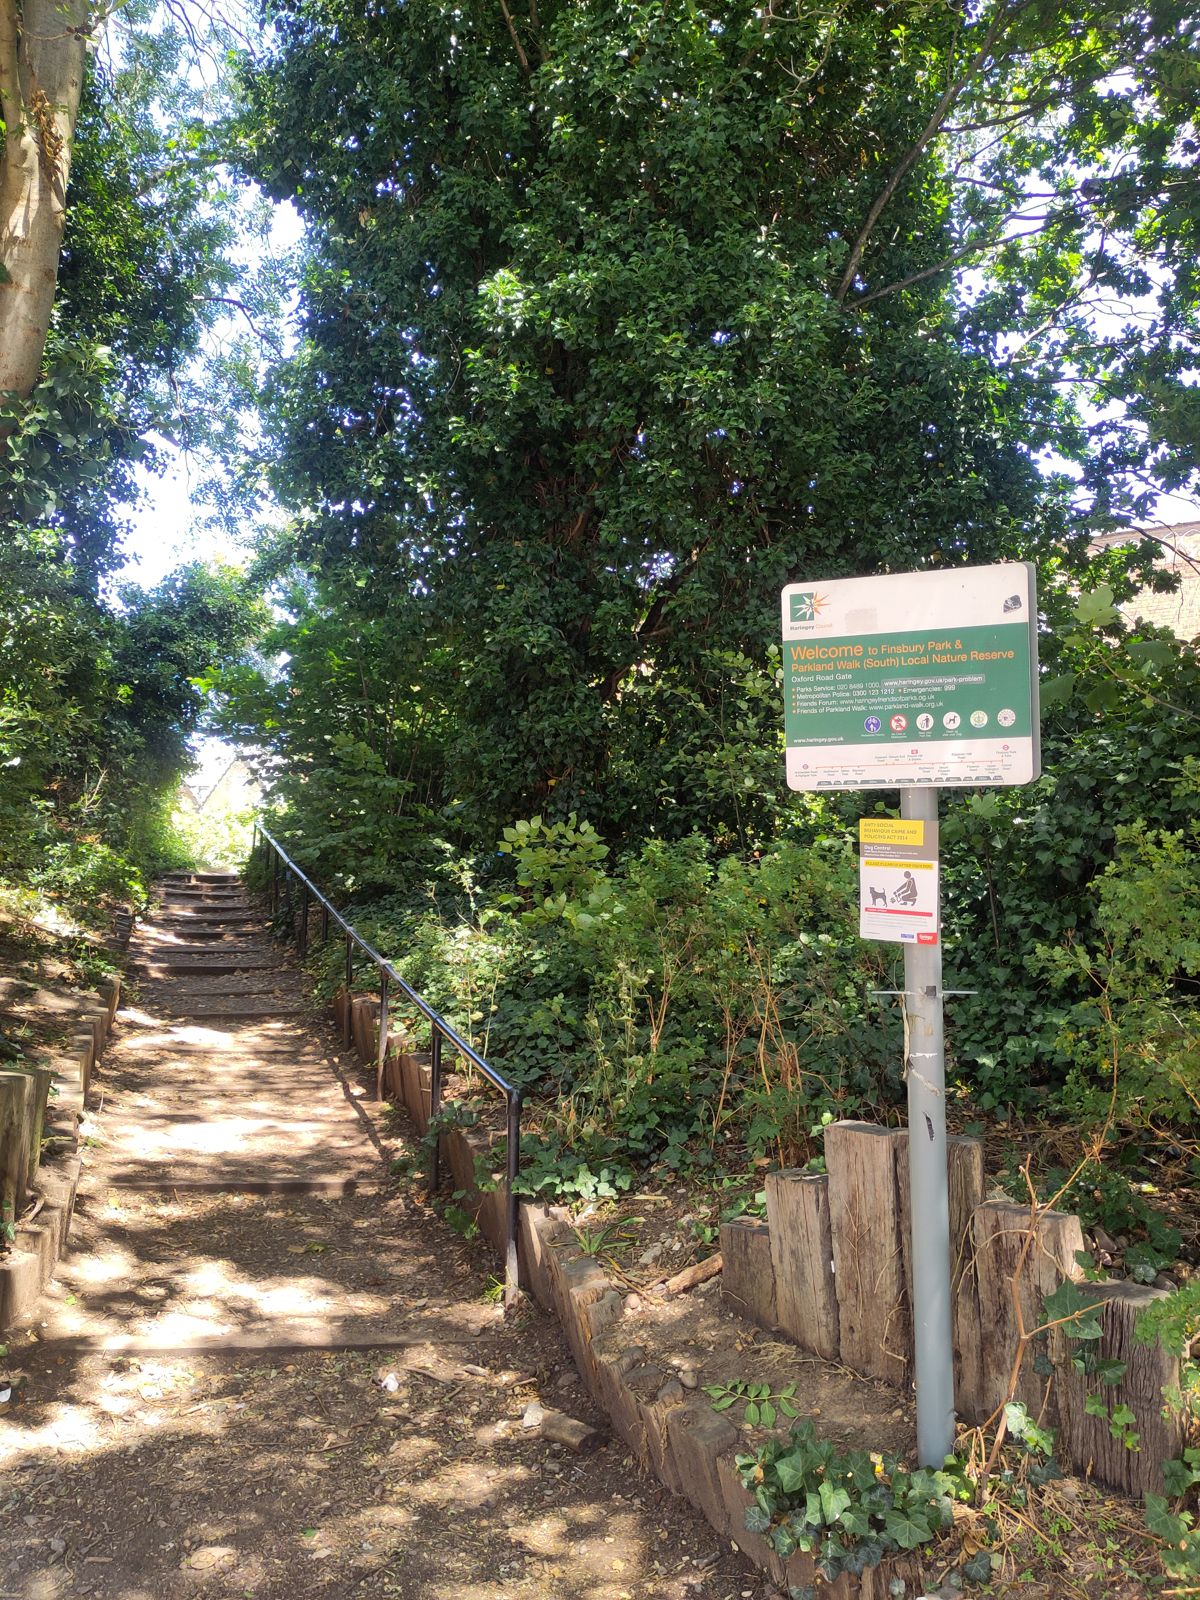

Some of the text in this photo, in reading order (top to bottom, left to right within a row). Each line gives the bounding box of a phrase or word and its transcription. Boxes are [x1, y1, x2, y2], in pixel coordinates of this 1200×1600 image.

[790, 640, 962, 660] Welcome to Finsbury Park &
[791, 650, 1014, 673] Parkland Walk (South) Local Nature Reserve
[791, 675, 814, 683] Oxford
[796, 692, 831, 700] Metropolitan
[903, 686, 943, 694] Emergencies:
[825, 705, 851, 713] Parkland
